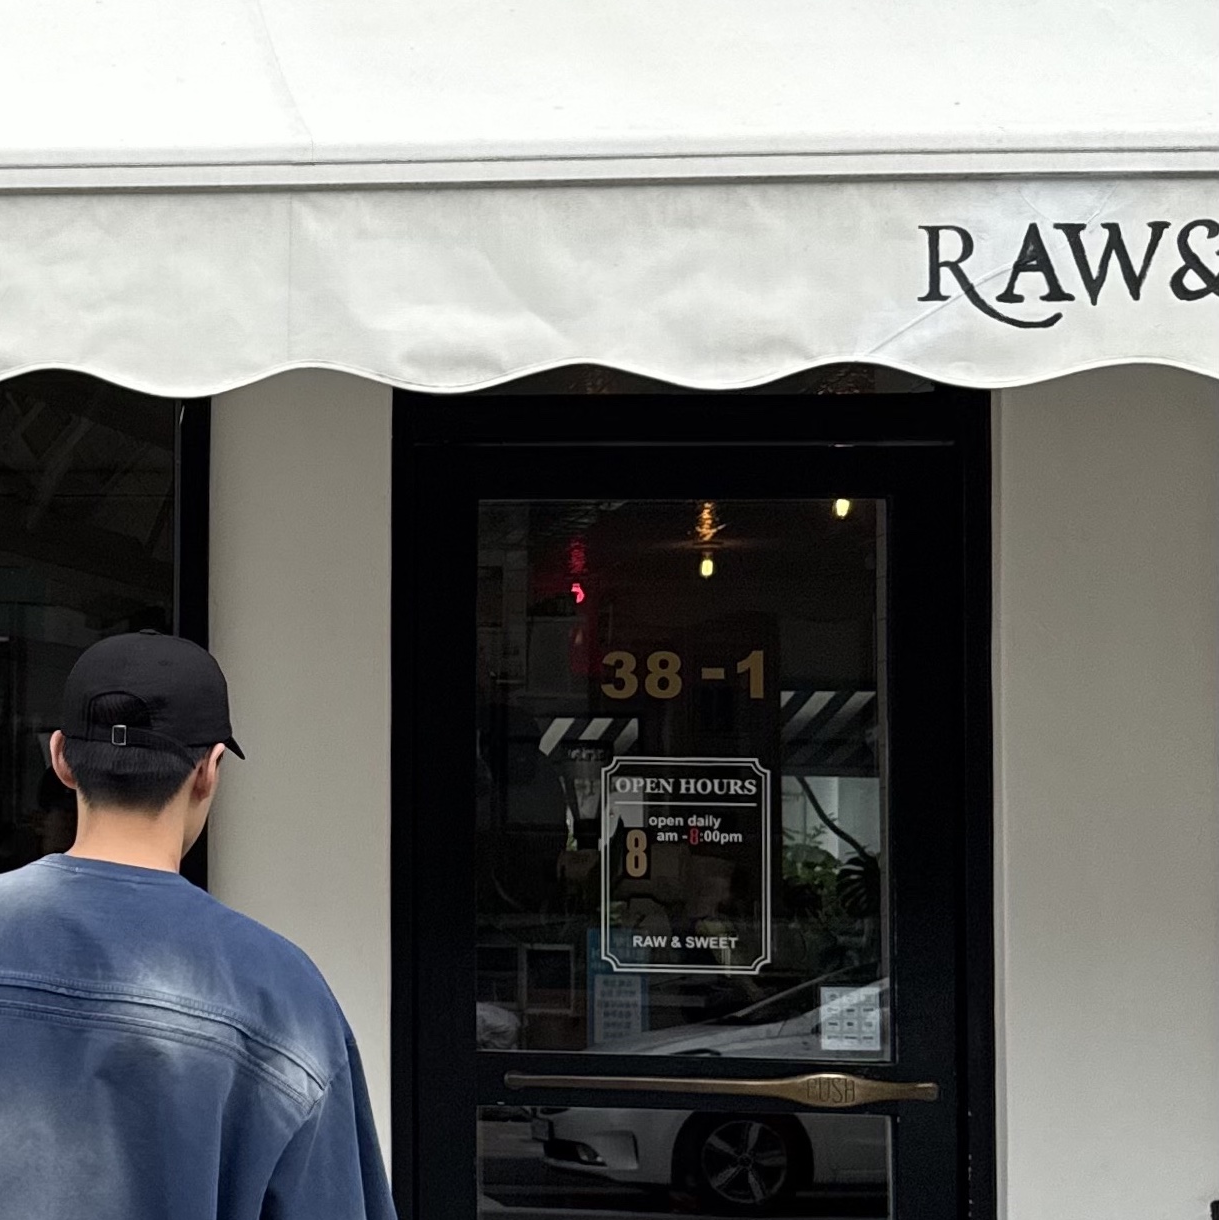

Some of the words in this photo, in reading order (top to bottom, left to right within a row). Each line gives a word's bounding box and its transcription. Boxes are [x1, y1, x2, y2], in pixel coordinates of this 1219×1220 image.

[615, 777, 674, 794] OPEN
[679, 778, 757, 795] HOURS
[648, 816, 684, 829] open
[687, 815, 722, 828] daily
[626, 829, 648, 878] 8
[656, 831, 679, 842] am
[632, 935, 668, 948] RAW
[671, 936, 682, 948] &
[685, 936, 739, 949] SWEET
[806, 1077, 856, 1103] PUSH
